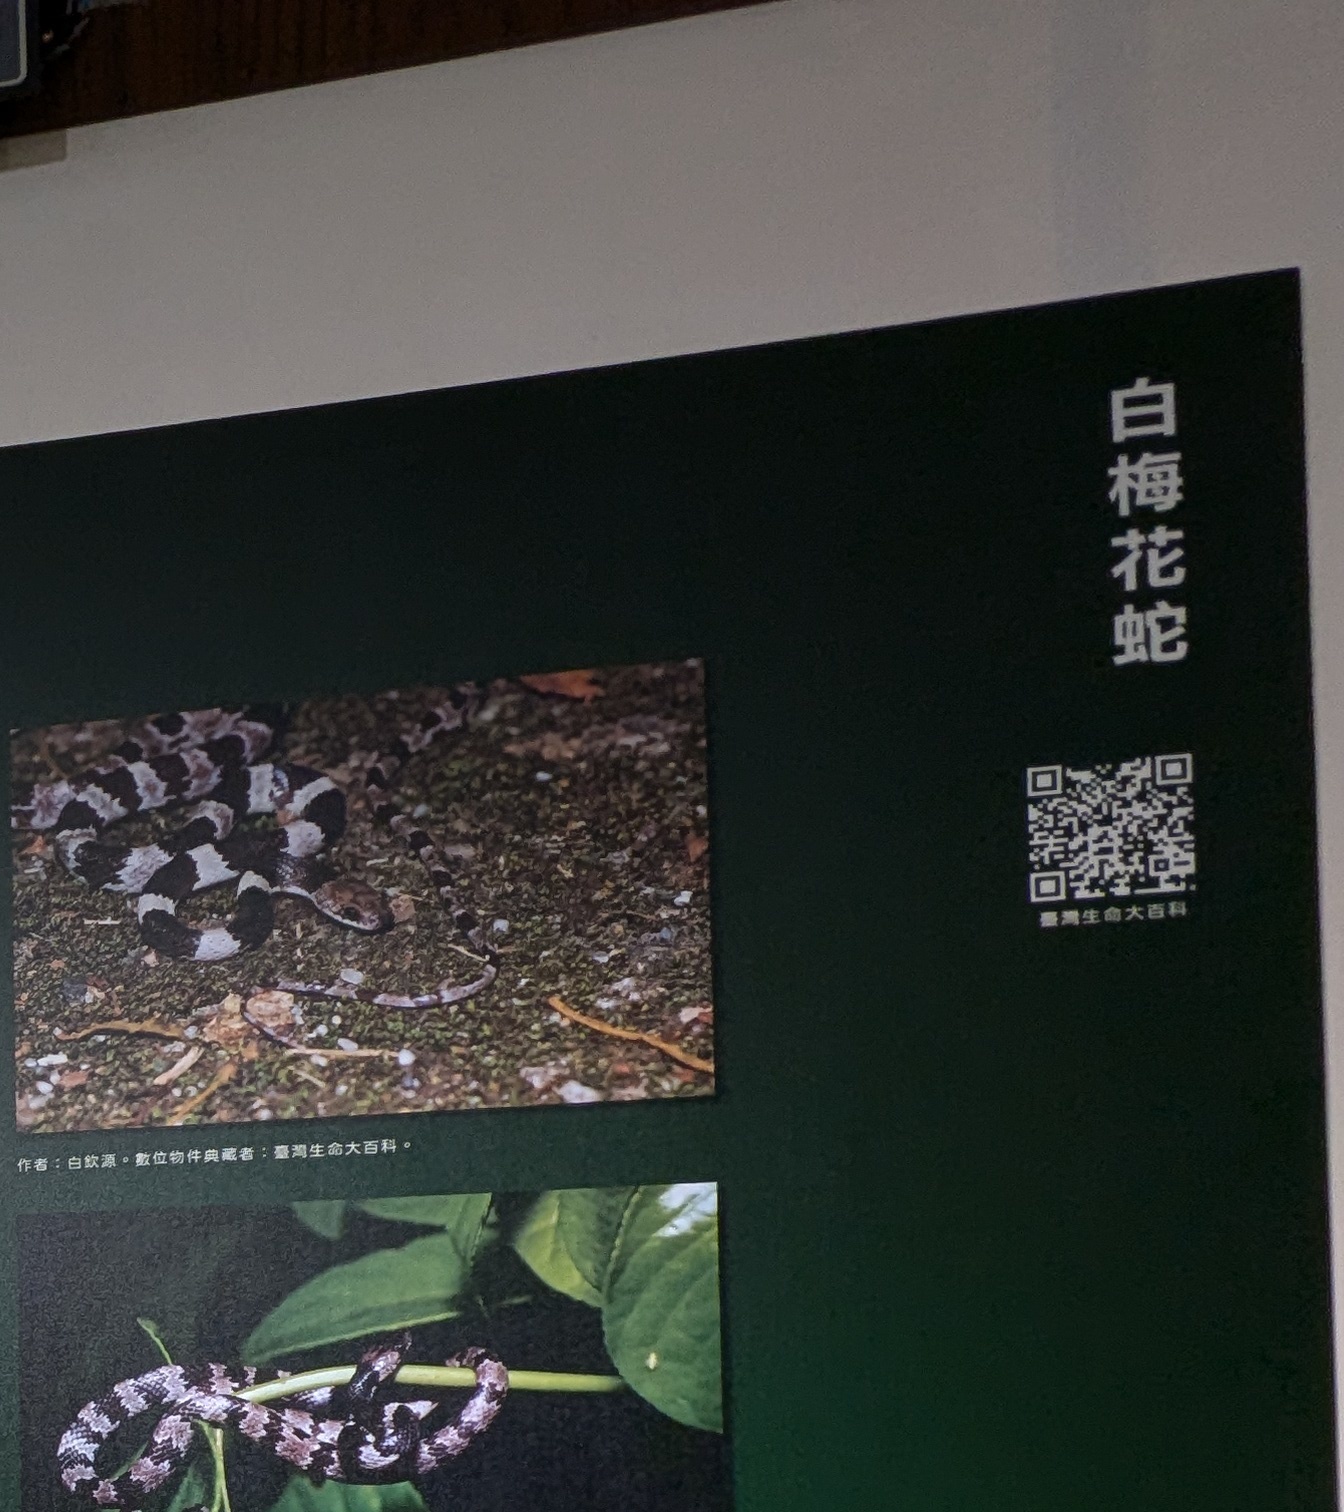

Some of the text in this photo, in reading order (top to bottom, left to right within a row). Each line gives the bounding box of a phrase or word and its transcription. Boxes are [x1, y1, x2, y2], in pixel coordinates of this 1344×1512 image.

[1108, 375, 1189, 668] 白梅花蛇
[1039, 901, 1188, 928] 臺灣生命大百科
